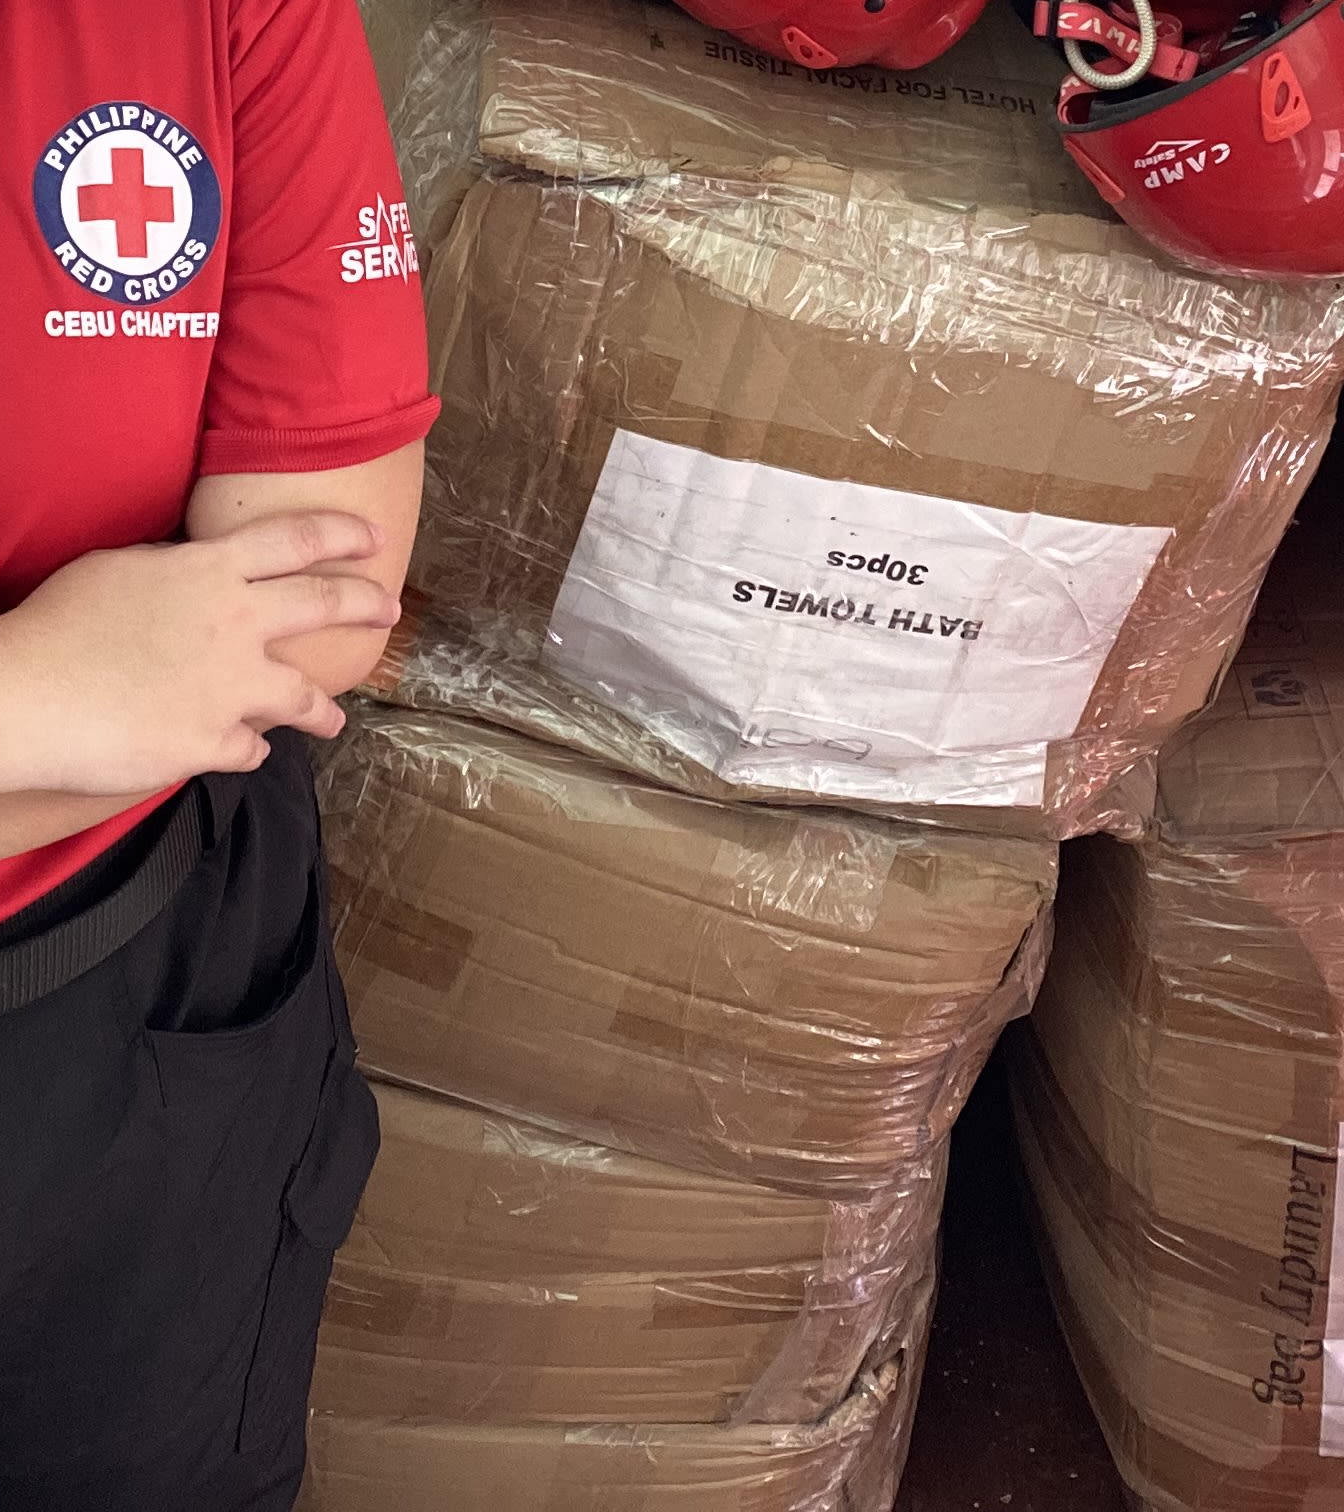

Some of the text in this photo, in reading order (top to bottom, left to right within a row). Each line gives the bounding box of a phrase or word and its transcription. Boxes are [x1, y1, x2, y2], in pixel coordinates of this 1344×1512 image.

[703, 39, 793, 77] TISSUE
[793, 66, 888, 95] FACIAL
[895, 77, 948, 102] FOR
[952, 85, 1036, 116] HOTEL
[43, 104, 203, 172] PHILIPPINE
[1134, 148, 1177, 169] Safety
[1143, 142, 1231, 189] CAMP
[53, 238, 207, 303] RED CROSS
[44, 309, 220, 339] CEBU CHAPTER
[826, 549, 929, 586] 30pcs
[732, 579, 984, 641] BATH TOWELS
[1261, 1146, 1338, 1328] Laundry
